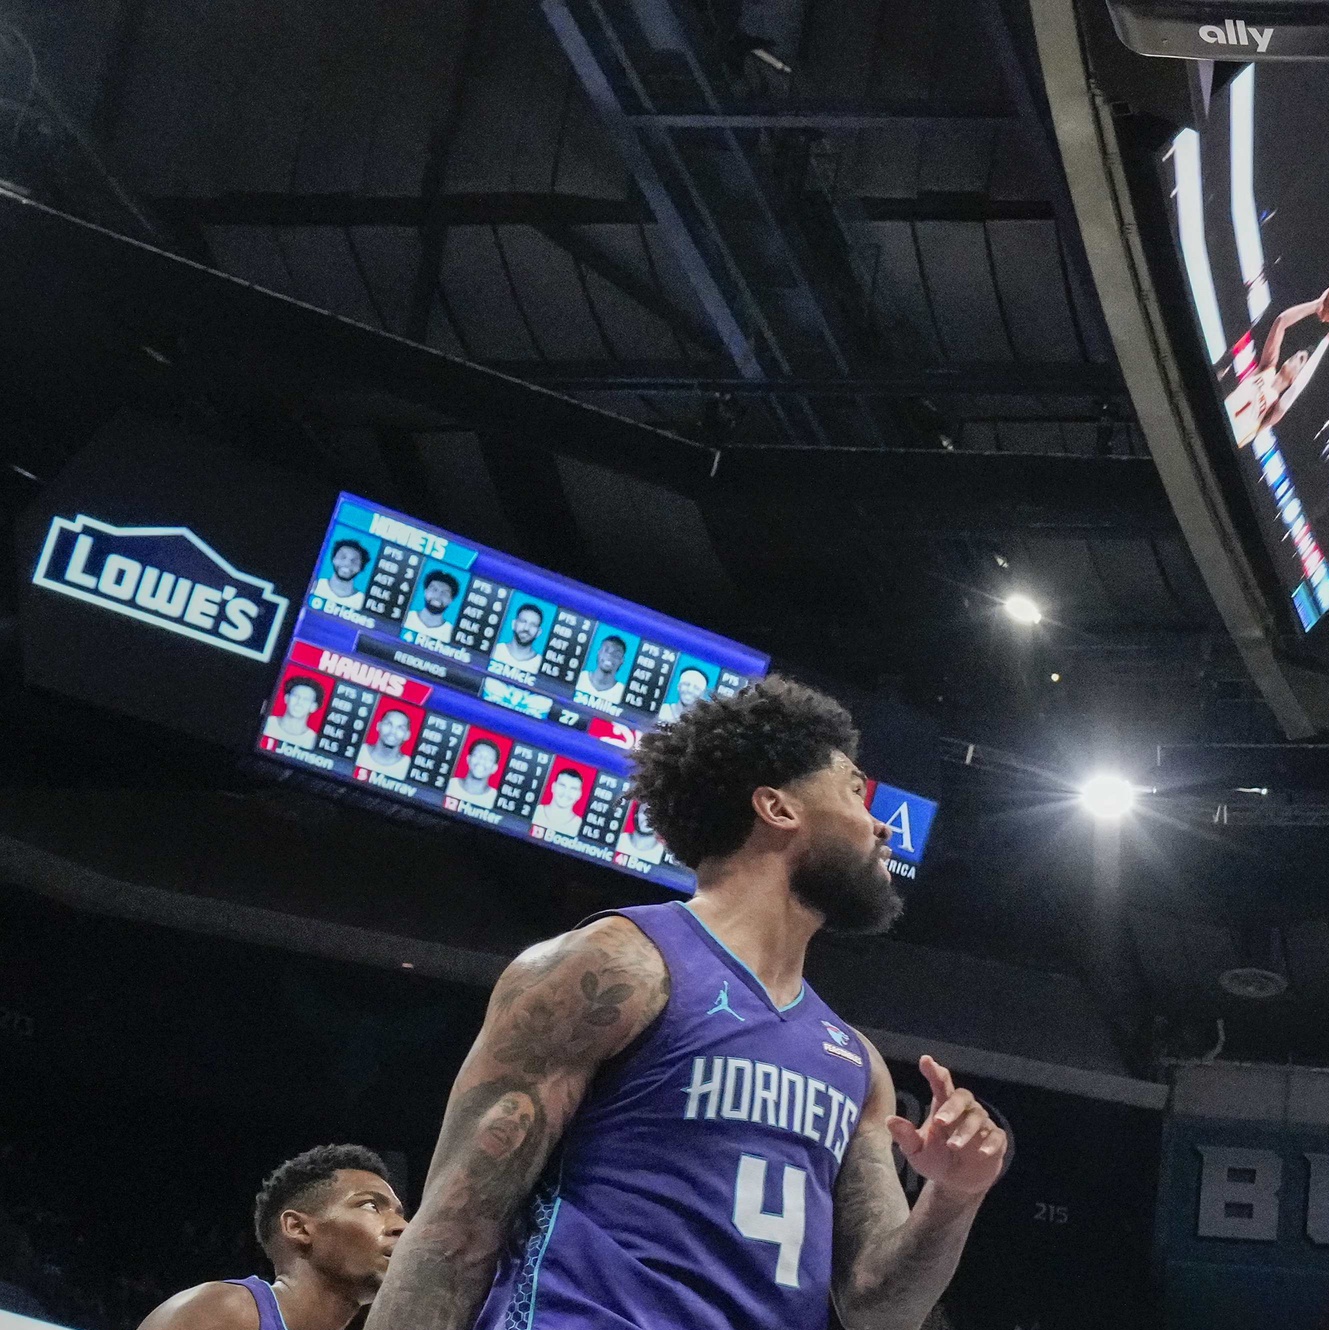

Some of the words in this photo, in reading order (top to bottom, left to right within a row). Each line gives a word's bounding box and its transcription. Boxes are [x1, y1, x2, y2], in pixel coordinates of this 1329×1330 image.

[1199, 19, 1274, 53] ally
[64, 534, 259, 641] LOWE'S
[415, 632, 472, 661] Richards
[318, 651, 407, 697] HAWKS
[394, 651, 447, 677] REBOUNDS
[502, 663, 536, 687] Micic
[558, 710, 580, 725] 27
[589, 695, 623, 717] Miller
[275, 740, 334, 770] Johnson
[368, 772, 417, 797] Murray
[457, 801, 503, 825] Hunter
[884, 801, 914, 853] A
[681, 1056, 858, 1165] HORNETS
[732, 1153, 807, 1288] 4
